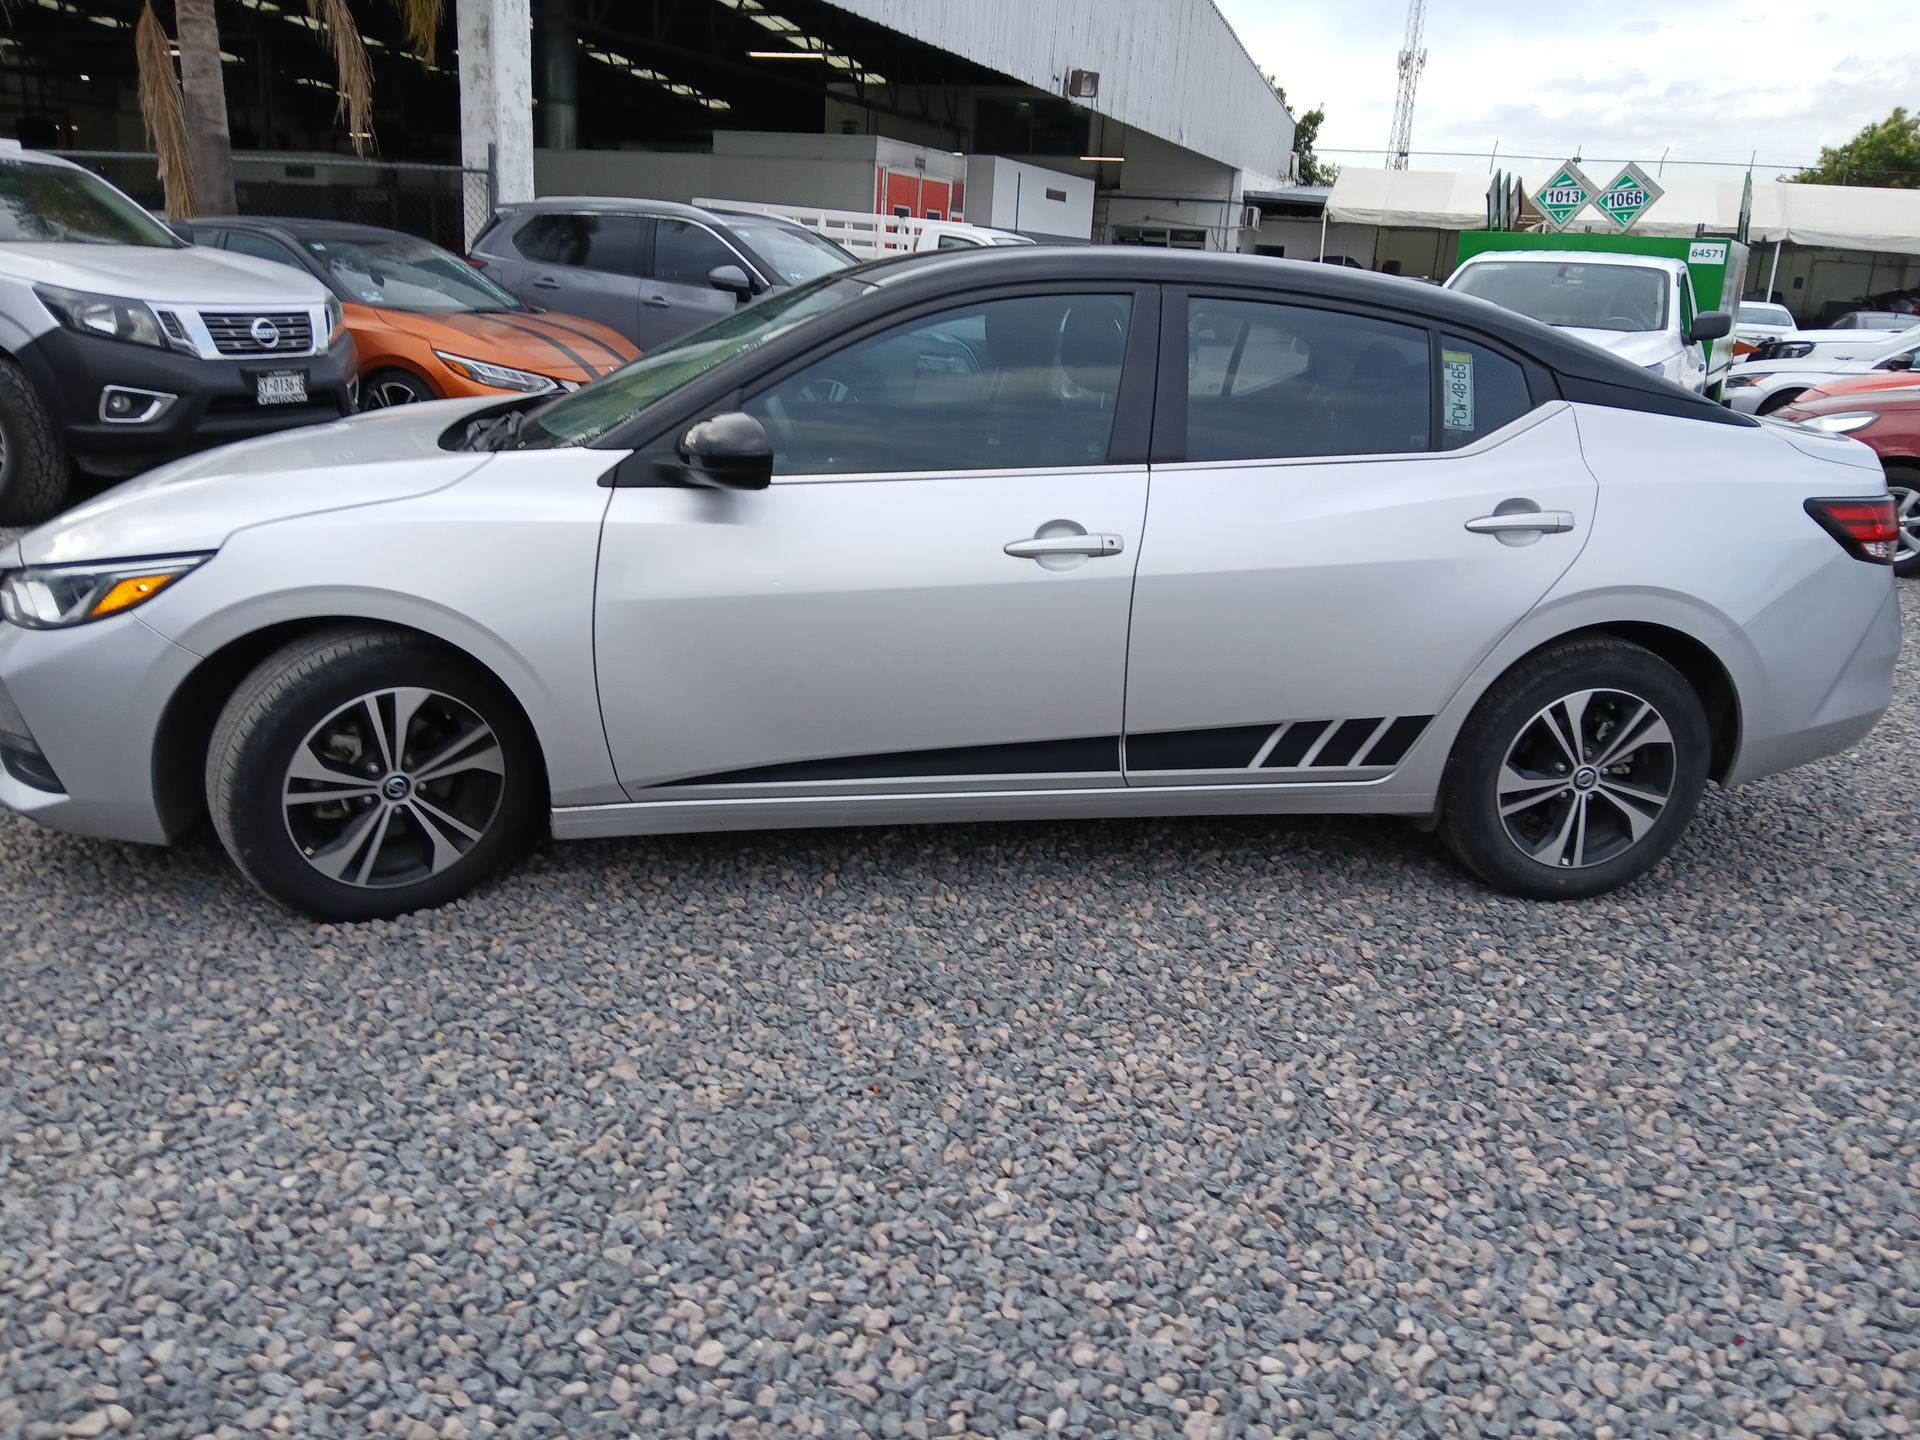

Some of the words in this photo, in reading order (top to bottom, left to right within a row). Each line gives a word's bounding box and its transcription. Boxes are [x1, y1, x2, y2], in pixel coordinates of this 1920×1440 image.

[1548, 190, 1580, 203] 1013
[1608, 191, 1643, 207] 1066
[1558, 211, 1564, 219] 2
[1622, 213, 1628, 221] 2
[1691, 248, 1724, 259] 64571
[1451, 363, 1467, 427] PCW-48-65
